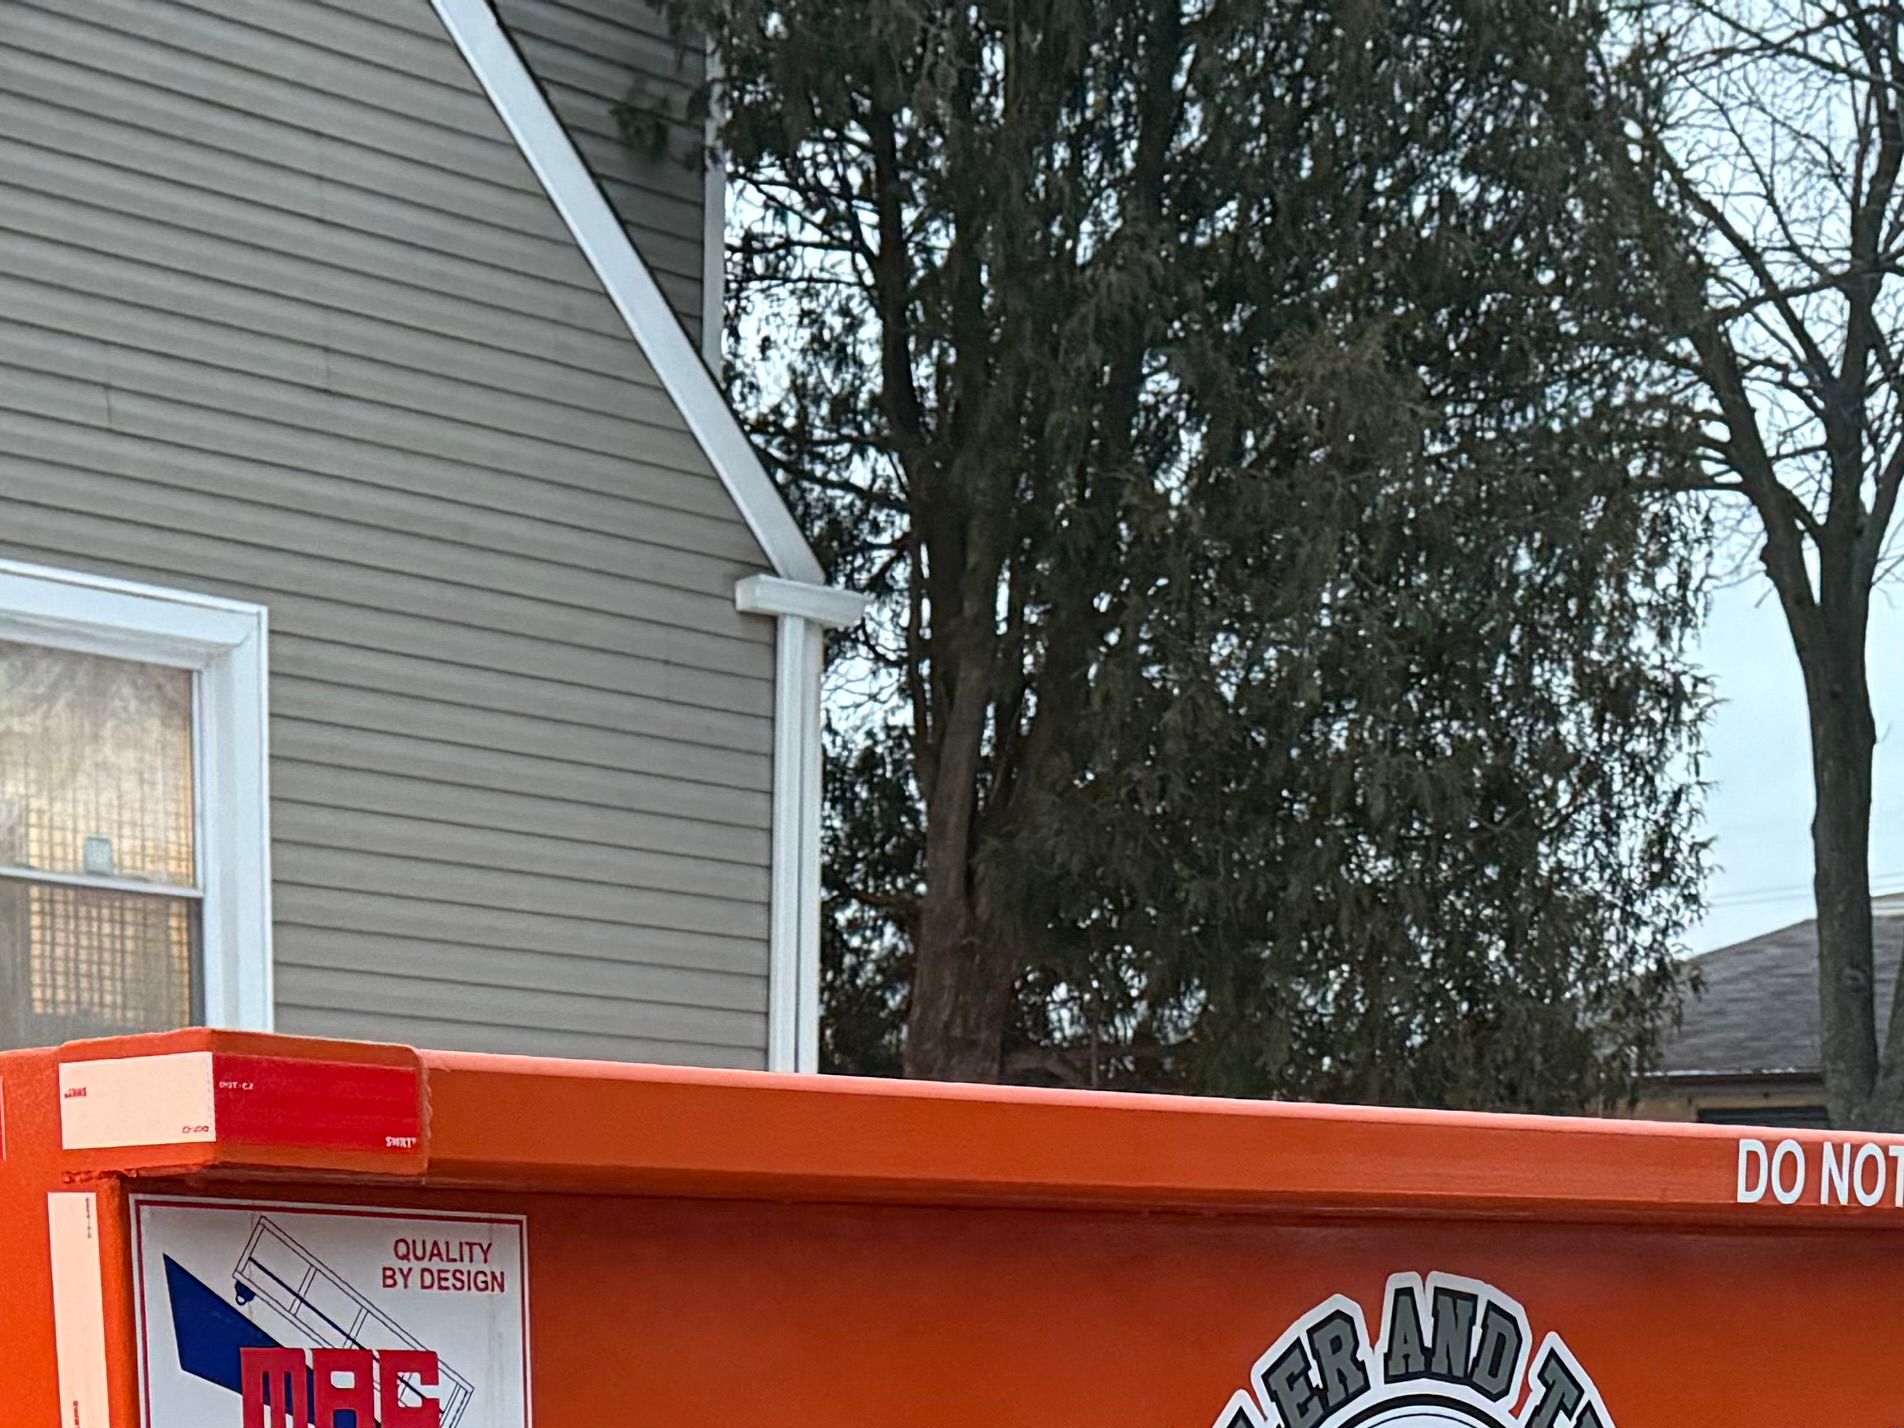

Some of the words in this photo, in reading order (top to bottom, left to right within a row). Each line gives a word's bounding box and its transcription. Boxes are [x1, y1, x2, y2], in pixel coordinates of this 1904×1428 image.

[1737, 1138, 1806, 1205] DO
[393, 1238, 492, 1264] QUALITY
[382, 1266, 412, 1289] BY
[420, 1267, 504, 1292] DESIGN
[1384, 1286, 1523, 1402] AND
